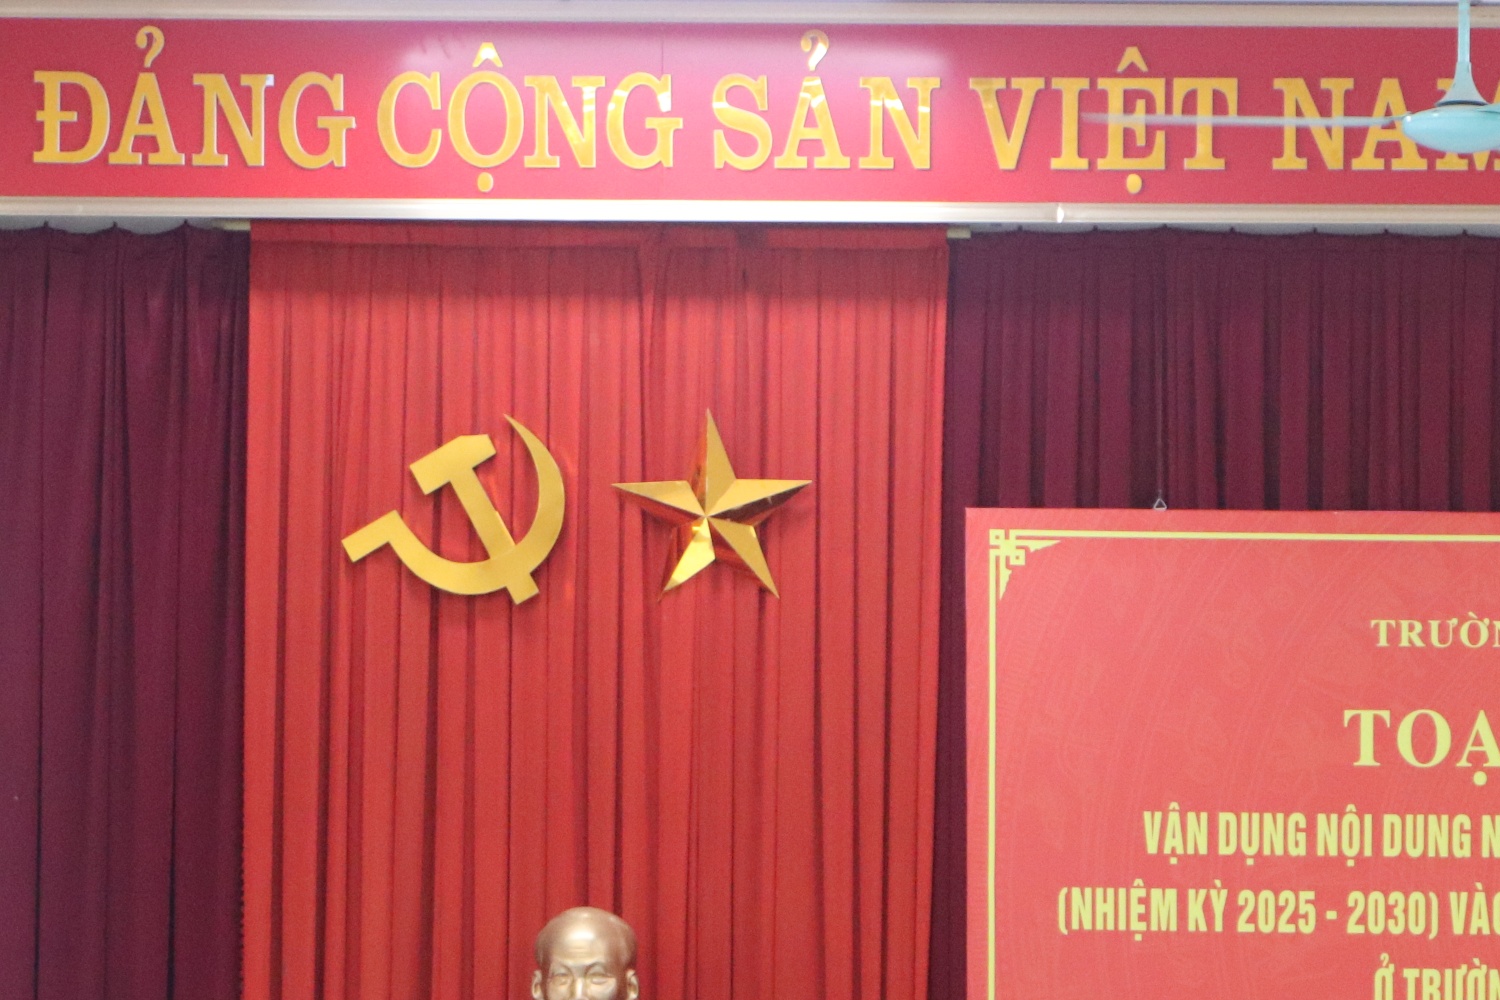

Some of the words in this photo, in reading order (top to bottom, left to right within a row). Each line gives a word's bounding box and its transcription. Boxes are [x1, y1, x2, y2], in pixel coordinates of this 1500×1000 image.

[33, 26, 356, 169] ĐẢNG
[377, 42, 683, 192] CỘNG
[711, 29, 941, 170] SẢN
[969, 46, 1238, 193] VIỆT
[1143, 801, 1208, 865] VẬN
[1217, 811, 1307, 866] DỤNG
[1316, 803, 1373, 867] NỘI
[1382, 813, 1472, 859] DUNG
[1057, 878, 1178, 942] (NHIỆM
[1187, 879, 1228, 933] KỲ
[1236, 889, 1317, 935] 2025
[1346, 890, 1439, 940] 2030)
